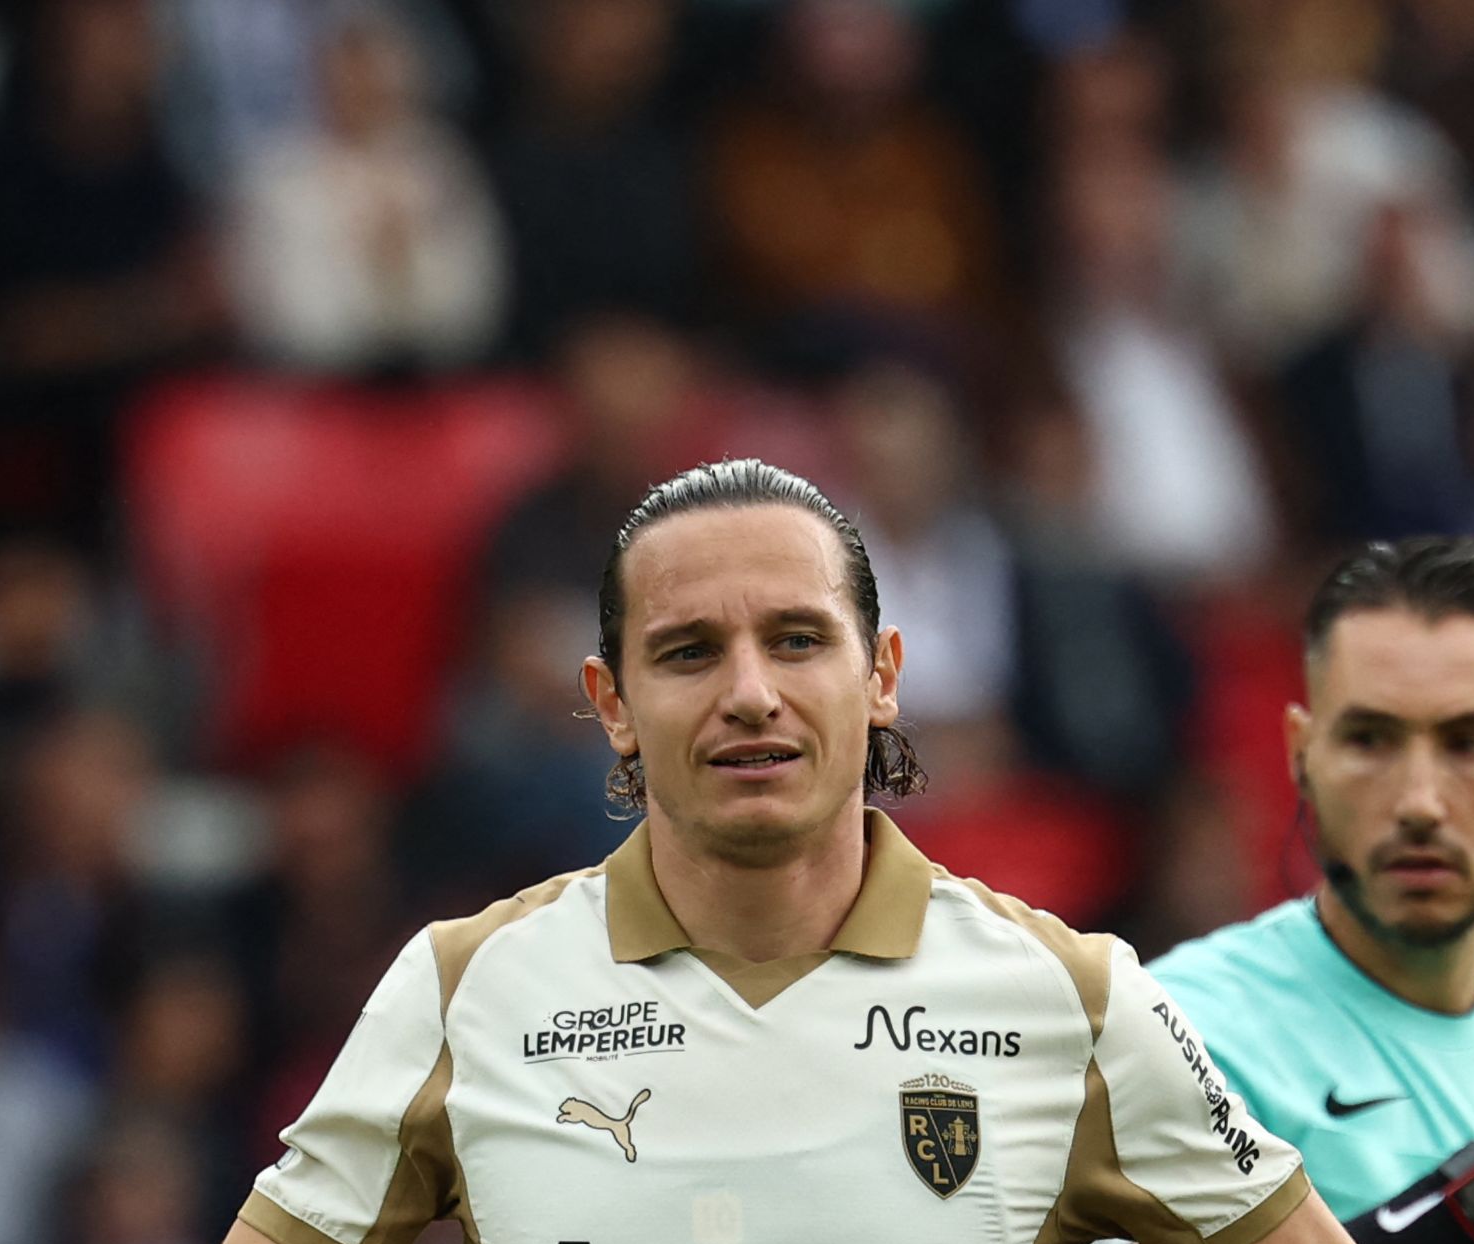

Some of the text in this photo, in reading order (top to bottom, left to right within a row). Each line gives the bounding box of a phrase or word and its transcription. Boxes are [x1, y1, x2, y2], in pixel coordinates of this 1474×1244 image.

[553, 1001, 659, 1031] GROUPE
[854, 1004, 1022, 1058] Nexans
[523, 1023, 686, 1058] LEMPEREUR
[923, 1073, 951, 1088] 120
